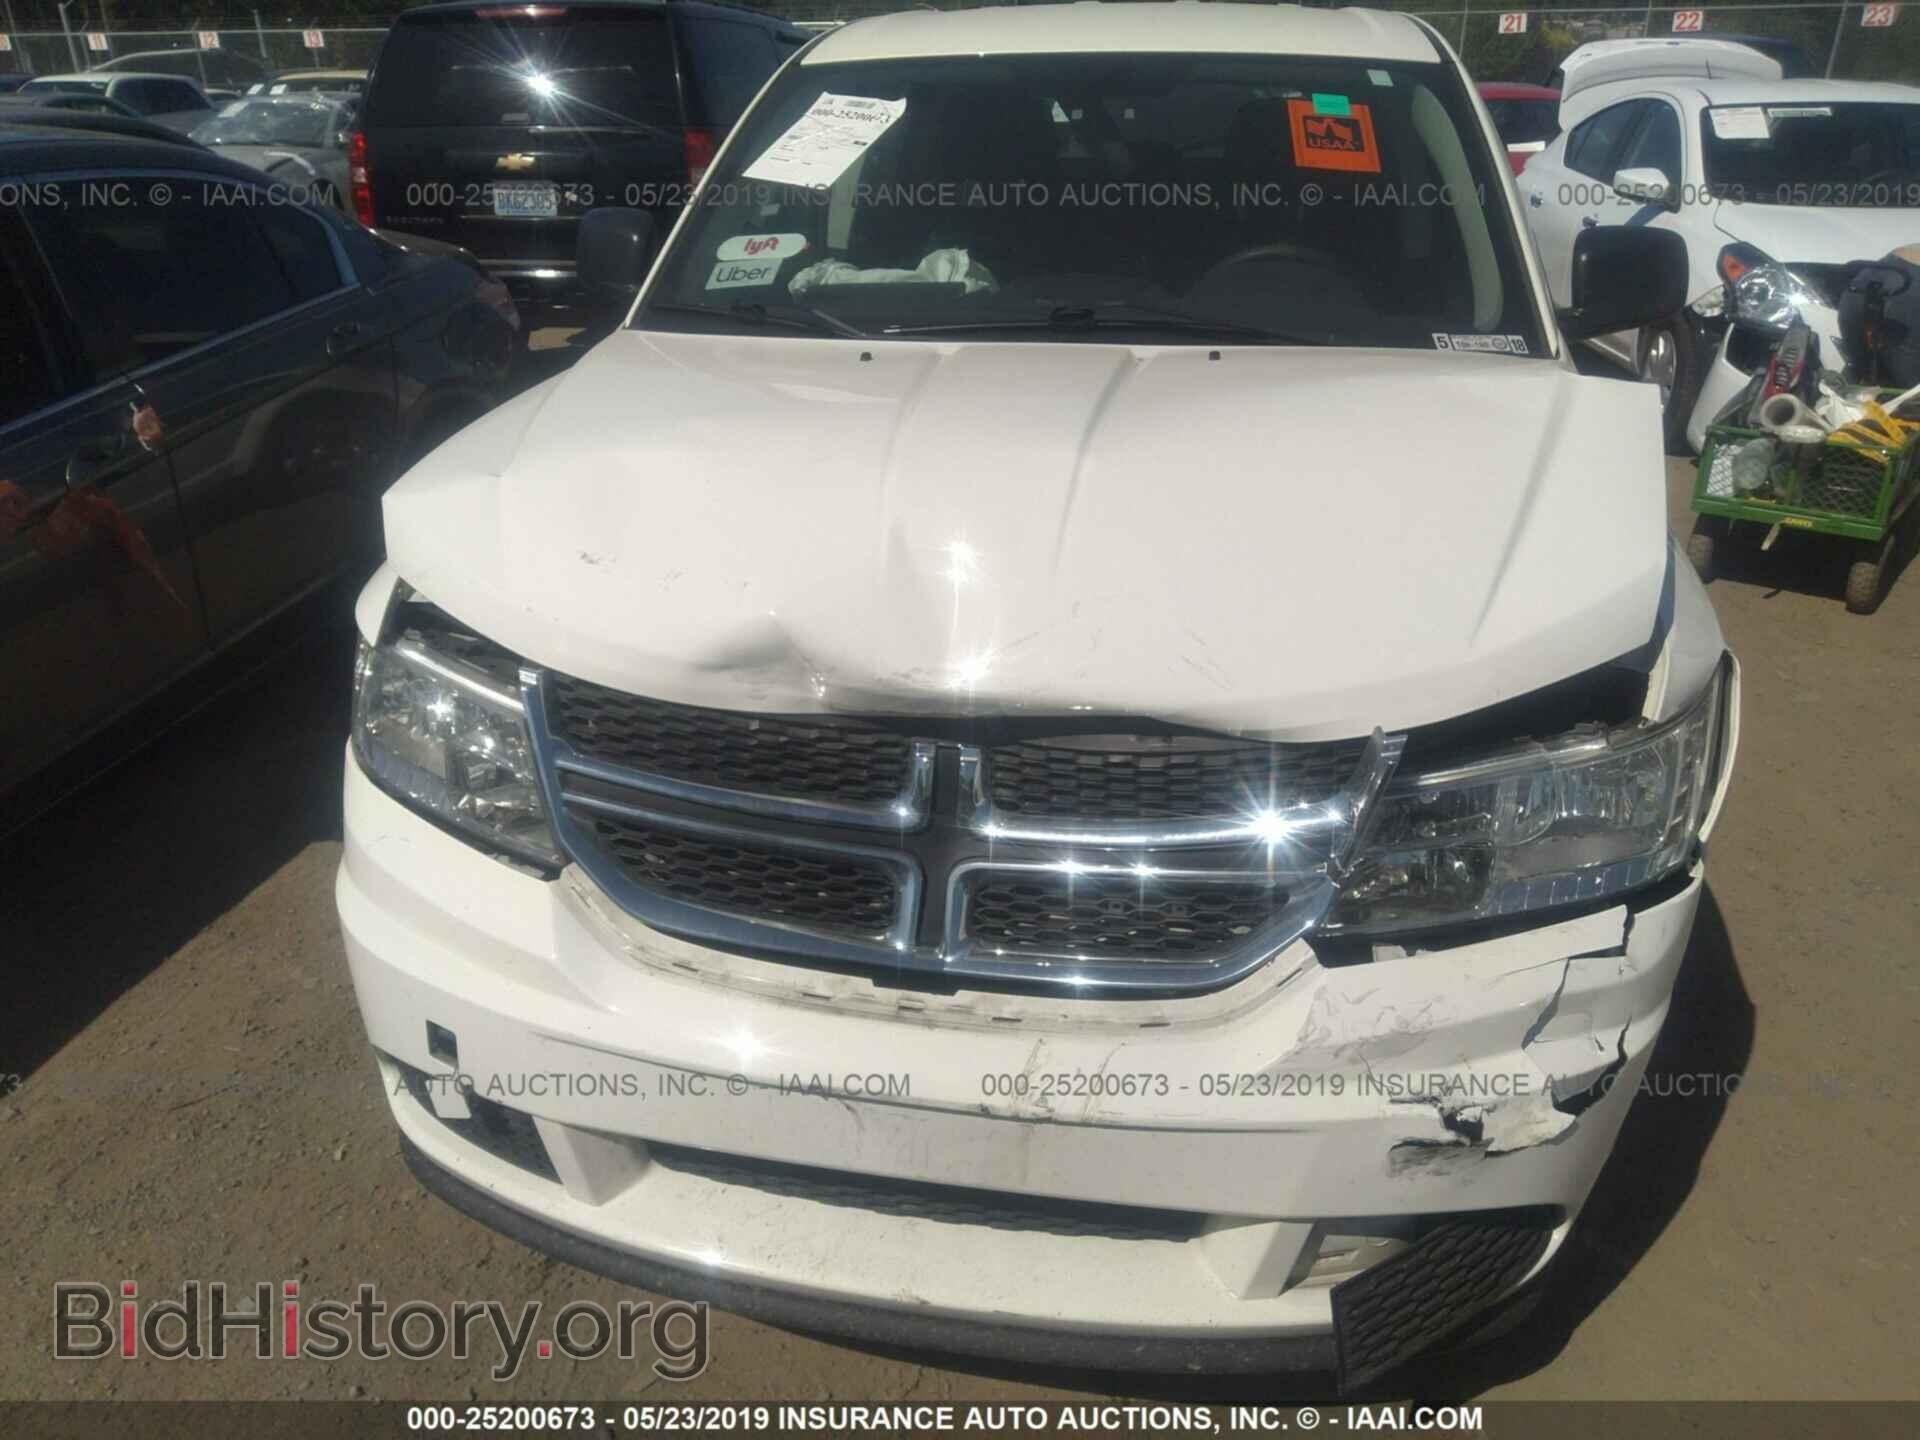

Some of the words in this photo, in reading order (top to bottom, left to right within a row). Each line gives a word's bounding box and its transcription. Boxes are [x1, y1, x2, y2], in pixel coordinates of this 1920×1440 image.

[1502, 14, 1524, 32] 21
[1674, 12, 1700, 31] 22
[1866, 6, 1893, 25] 23
[1308, 137, 1359, 152] USAA
[715, 265, 773, 283] Uber
[1436, 335, 1449, 350] 5
[1509, 338, 1526, 353] 18
